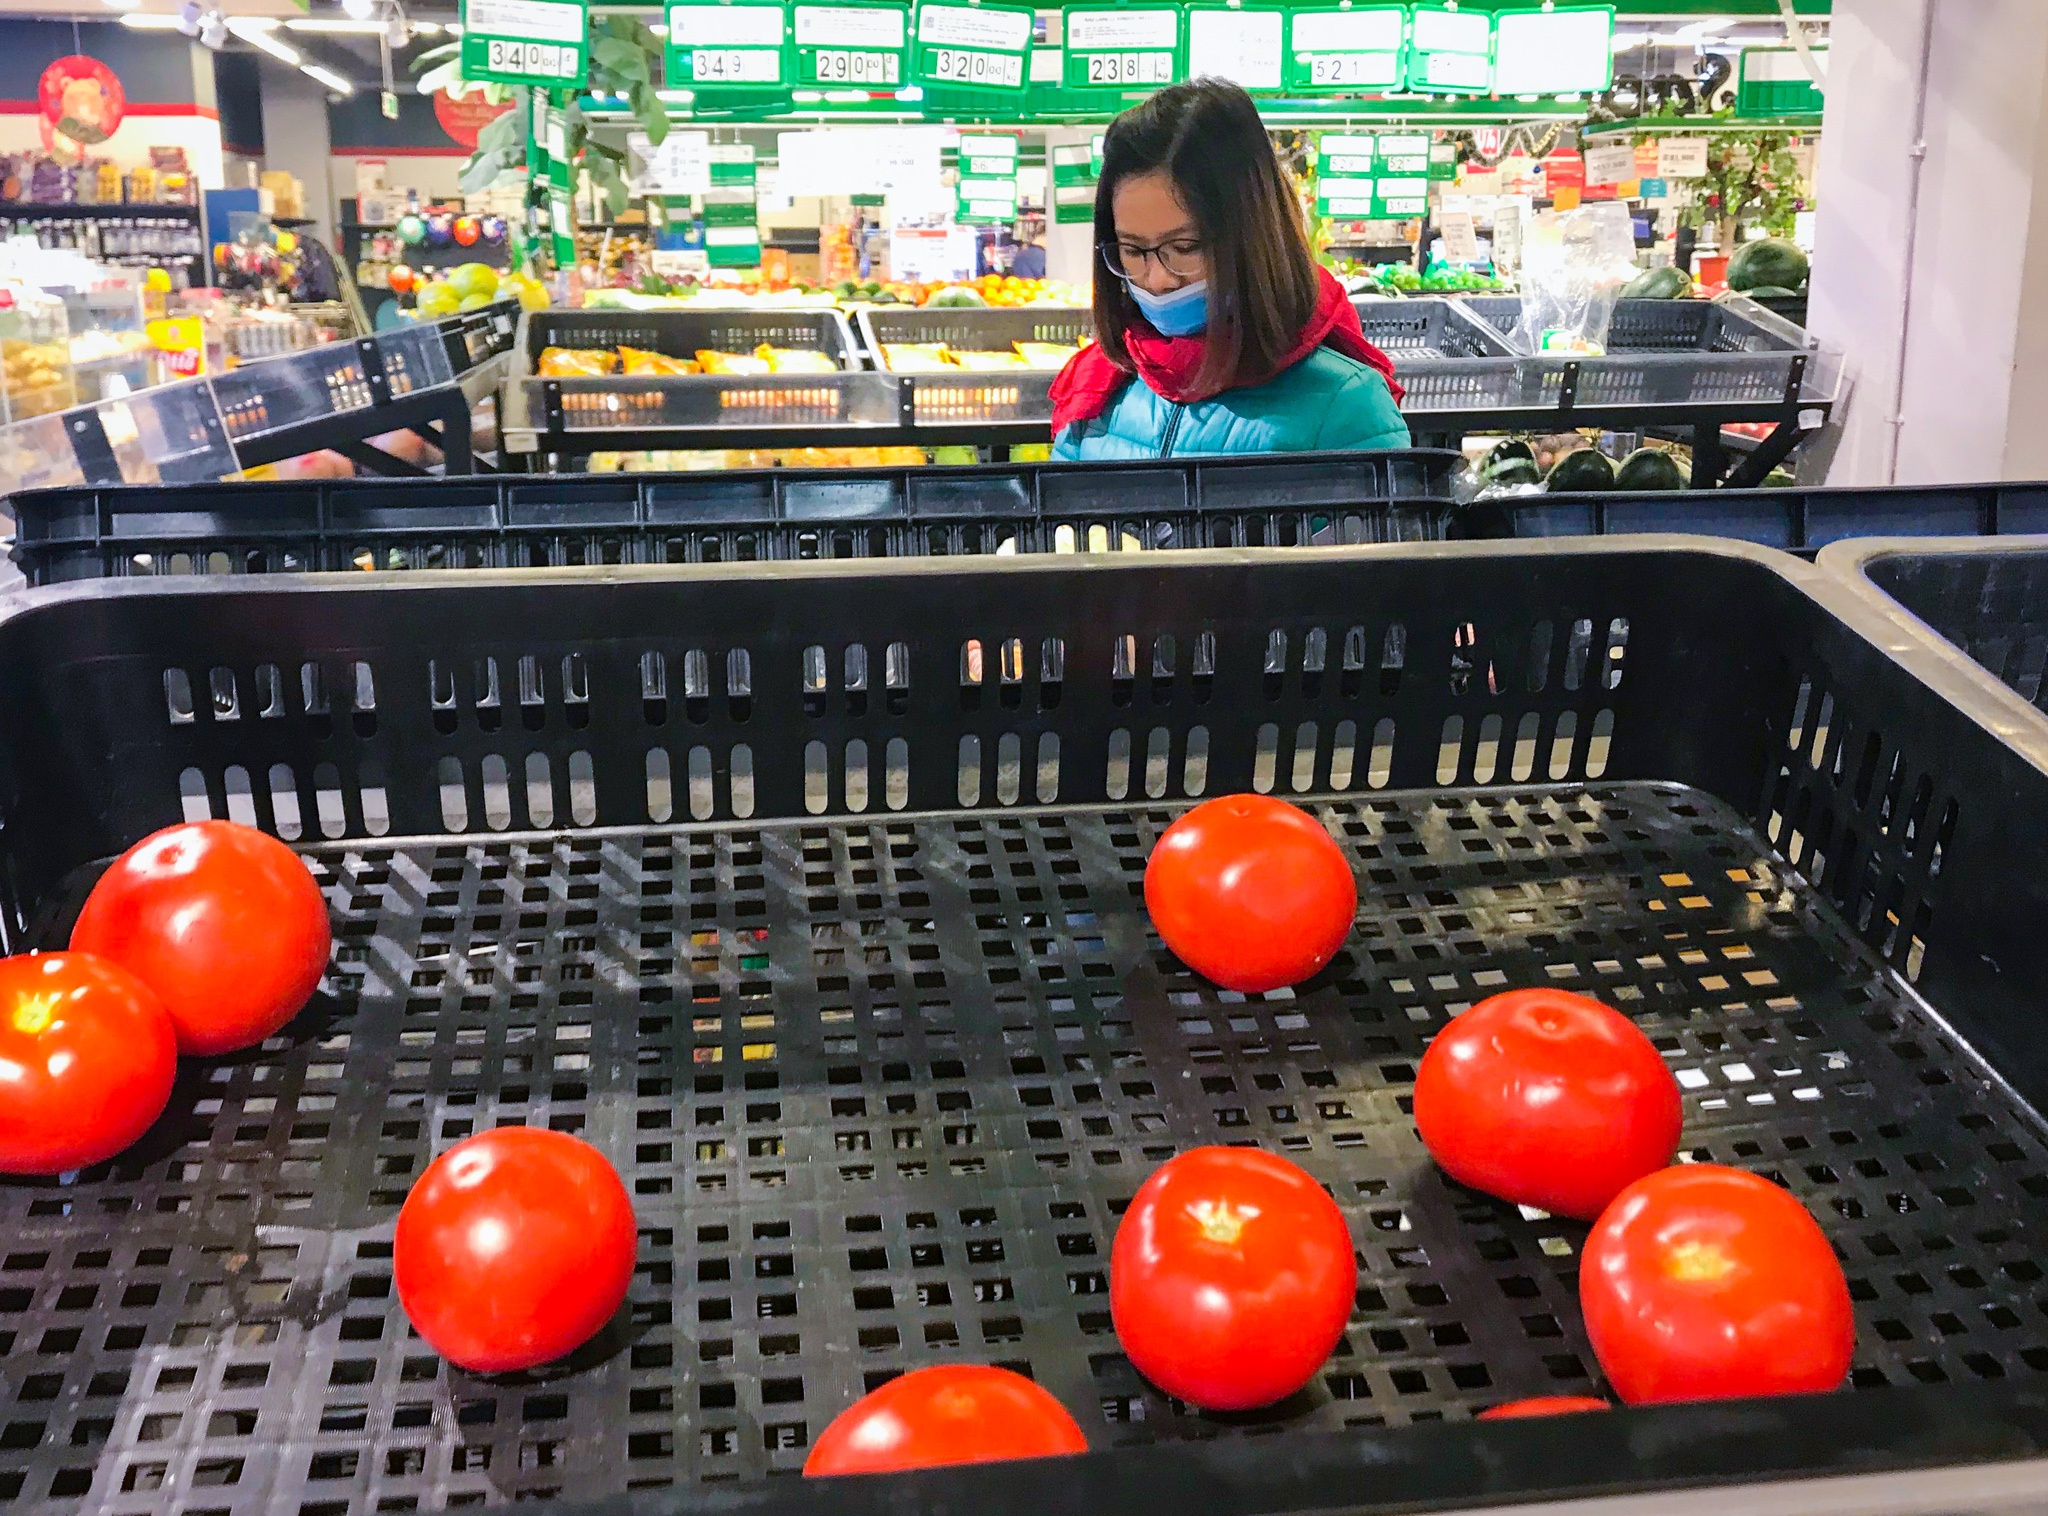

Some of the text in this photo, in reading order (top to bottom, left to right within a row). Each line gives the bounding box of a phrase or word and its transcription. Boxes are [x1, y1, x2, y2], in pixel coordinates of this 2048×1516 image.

[697, 54, 741, 77] 349
[1092, 58, 1136, 81] 238
[1316, 59, 1358, 81] 521
